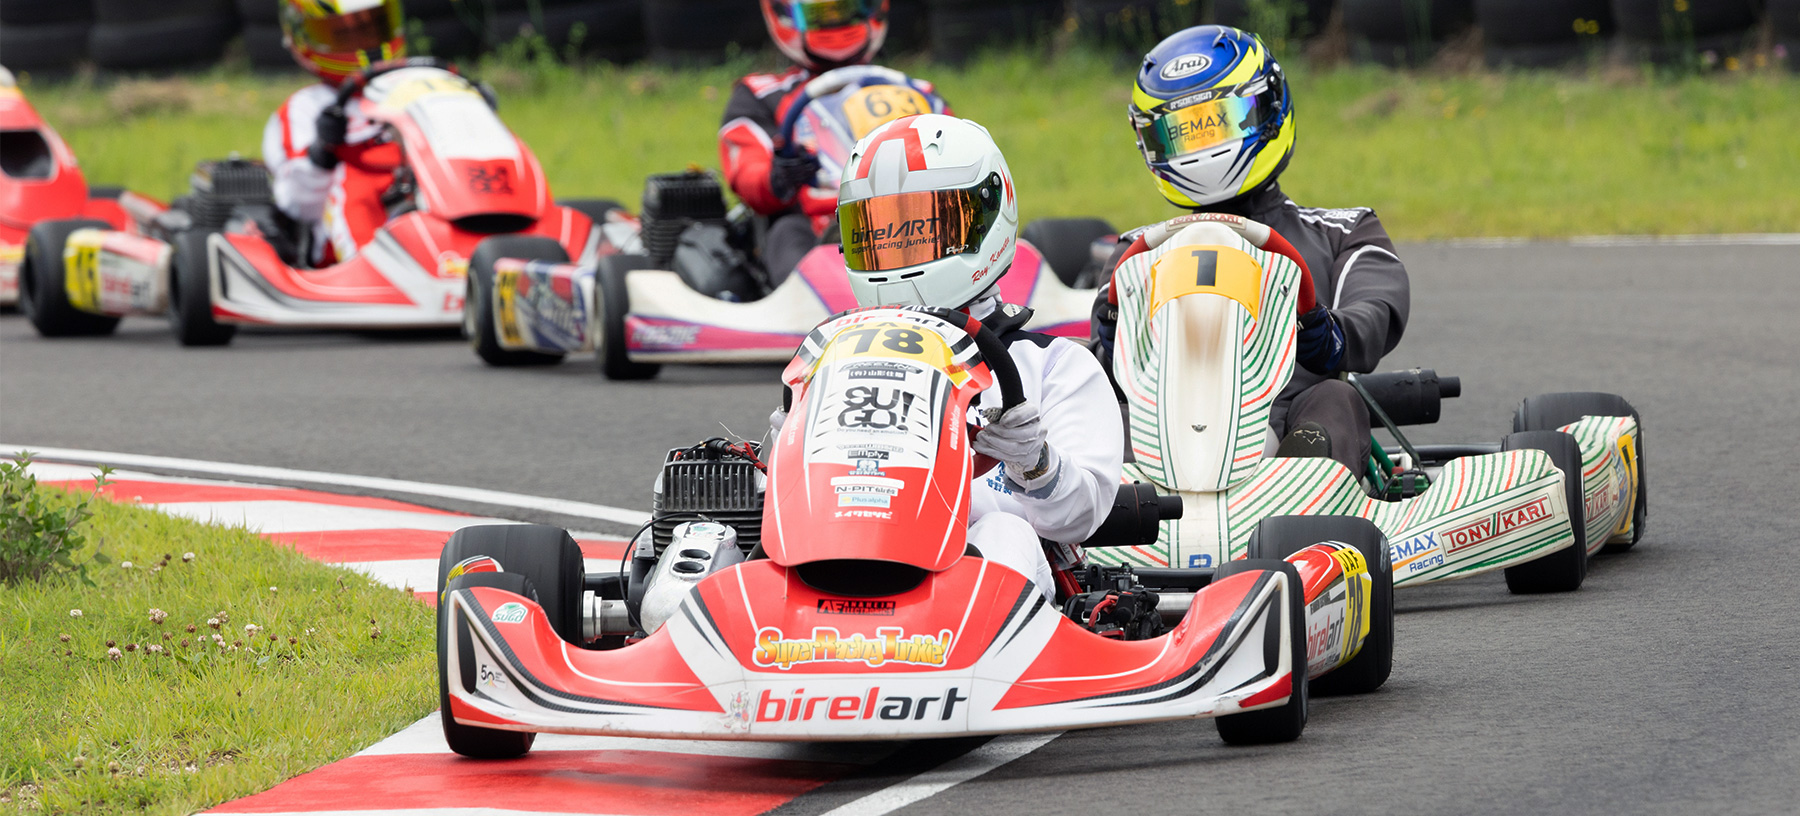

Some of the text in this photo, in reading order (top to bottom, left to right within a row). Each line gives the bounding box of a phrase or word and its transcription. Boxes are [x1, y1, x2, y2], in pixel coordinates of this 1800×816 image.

[1170, 58, 1203, 73] Arai
[864, 88, 921, 118] 63
[1168, 113, 1228, 141] BEMAX
[1184, 129, 1215, 142] Racing
[852, 218, 940, 244] birelART
[873, 239, 903, 251] racing
[1191, 250, 1218, 287] 1
[837, 328, 924, 355] 78
[1442, 519, 1491, 549] TONY
[1502, 497, 1548, 529] KART
[1390, 531, 1438, 562] EMAX
[1338, 550, 1359, 573] JAF
[1409, 554, 1444, 573] Racing
[1343, 572, 1363, 661] 78
[755, 686, 968, 722] birelart
